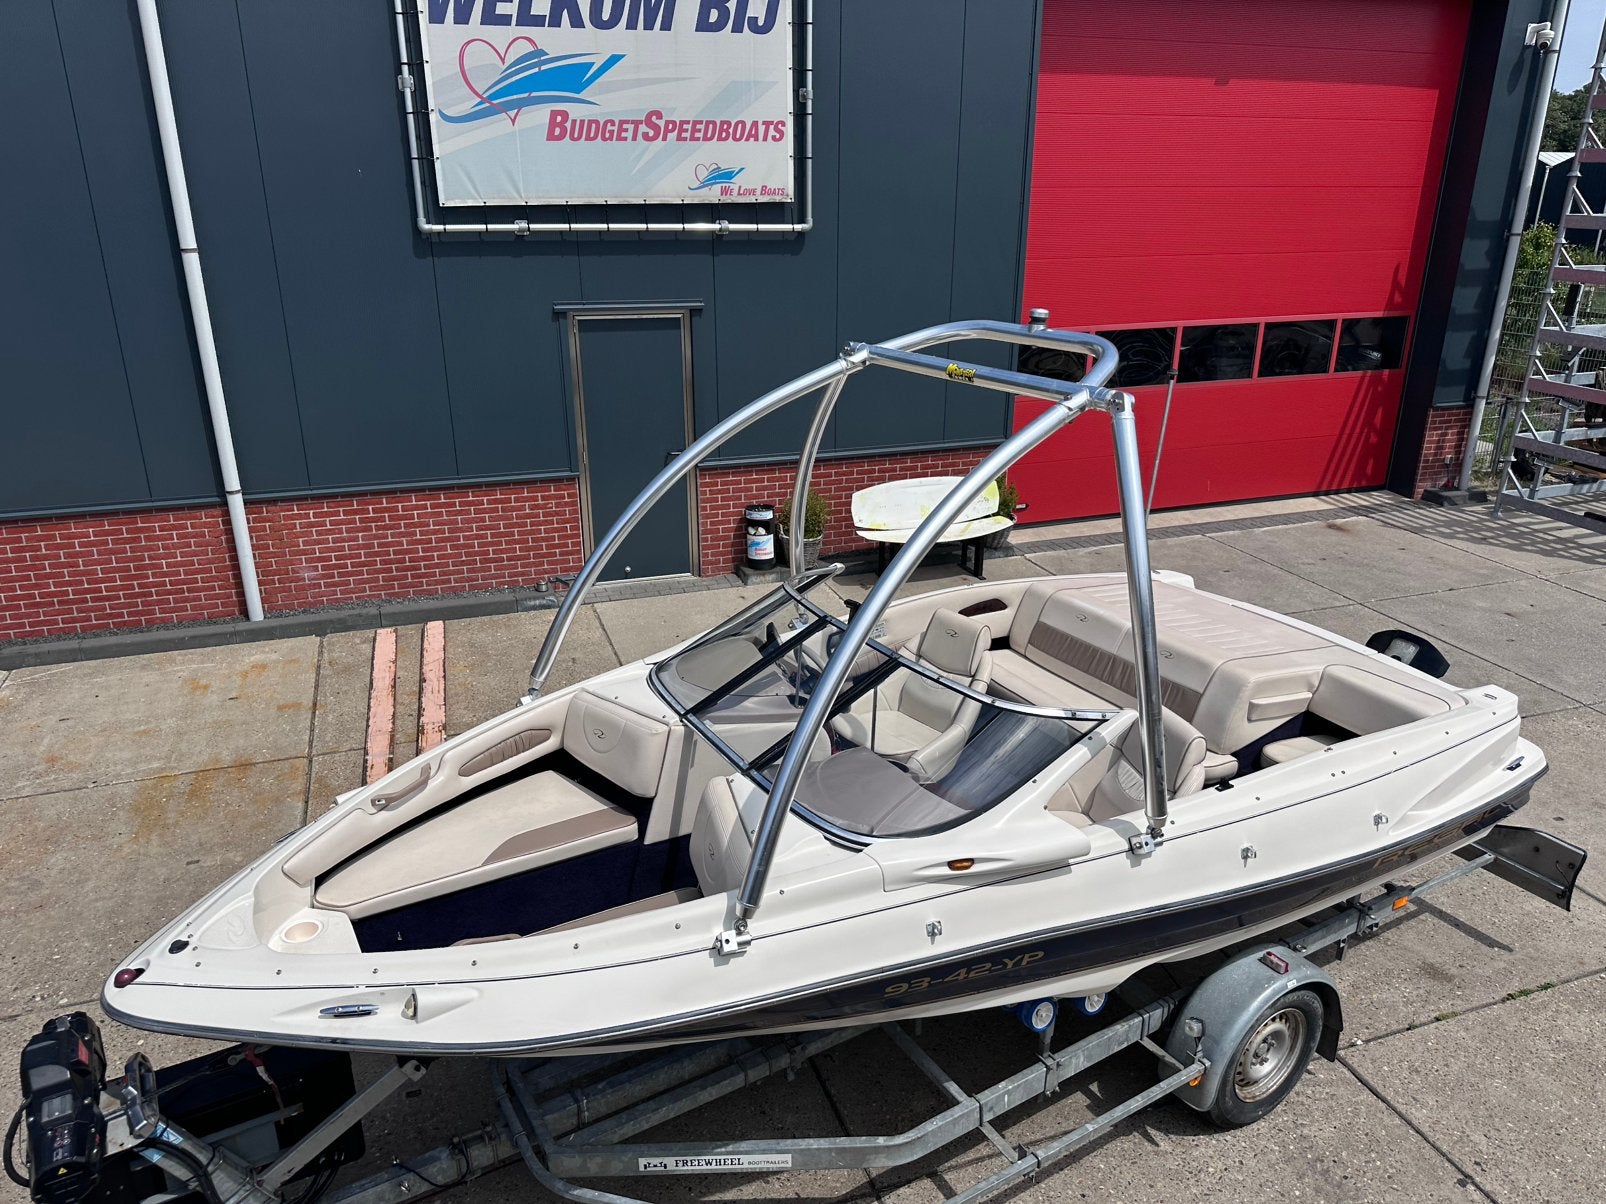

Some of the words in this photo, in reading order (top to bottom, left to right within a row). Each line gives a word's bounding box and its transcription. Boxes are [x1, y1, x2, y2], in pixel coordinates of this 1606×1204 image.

[695, 0, 781, 34] BIJ
[546, 109, 786, 142] BUDGETSPEEDBOATS
[720, 185, 734, 196] WE
[737, 185, 757, 196] LOVE
[760, 185, 785, 196] BOATS
[884, 950, 1046, 994] 93-42-YP
[674, 1157, 744, 1168] FREEWHEEL
